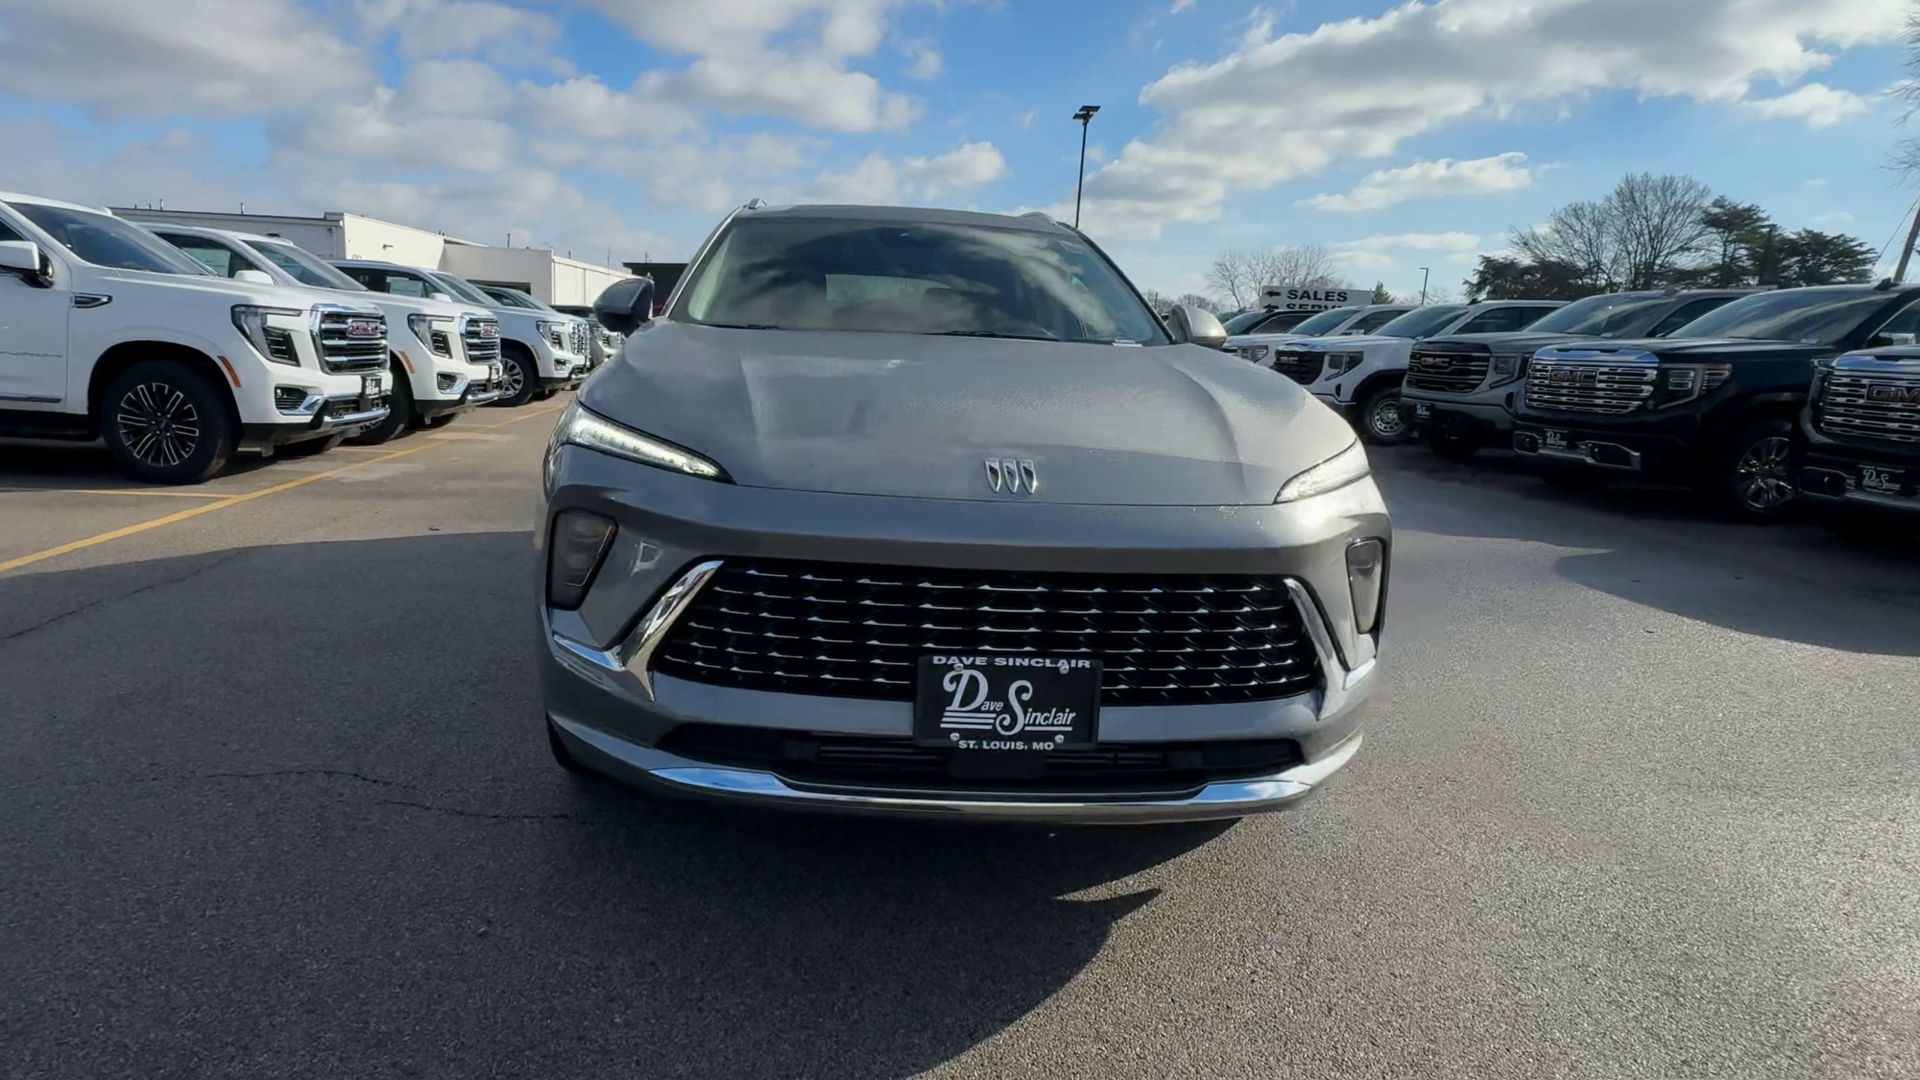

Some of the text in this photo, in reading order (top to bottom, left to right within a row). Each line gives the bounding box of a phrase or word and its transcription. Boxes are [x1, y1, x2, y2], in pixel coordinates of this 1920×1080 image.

[1286, 289, 1348, 302] SALES
[1550, 370, 1595, 384] GMC
[1870, 385, 1920, 402] GM
[933, 655, 1091, 669] DAVE SINCLAIR
[943, 669, 1076, 735] Dave Sinclair
[958, 740, 978, 750] ST.
[1032, 741, 1055, 751] MO
